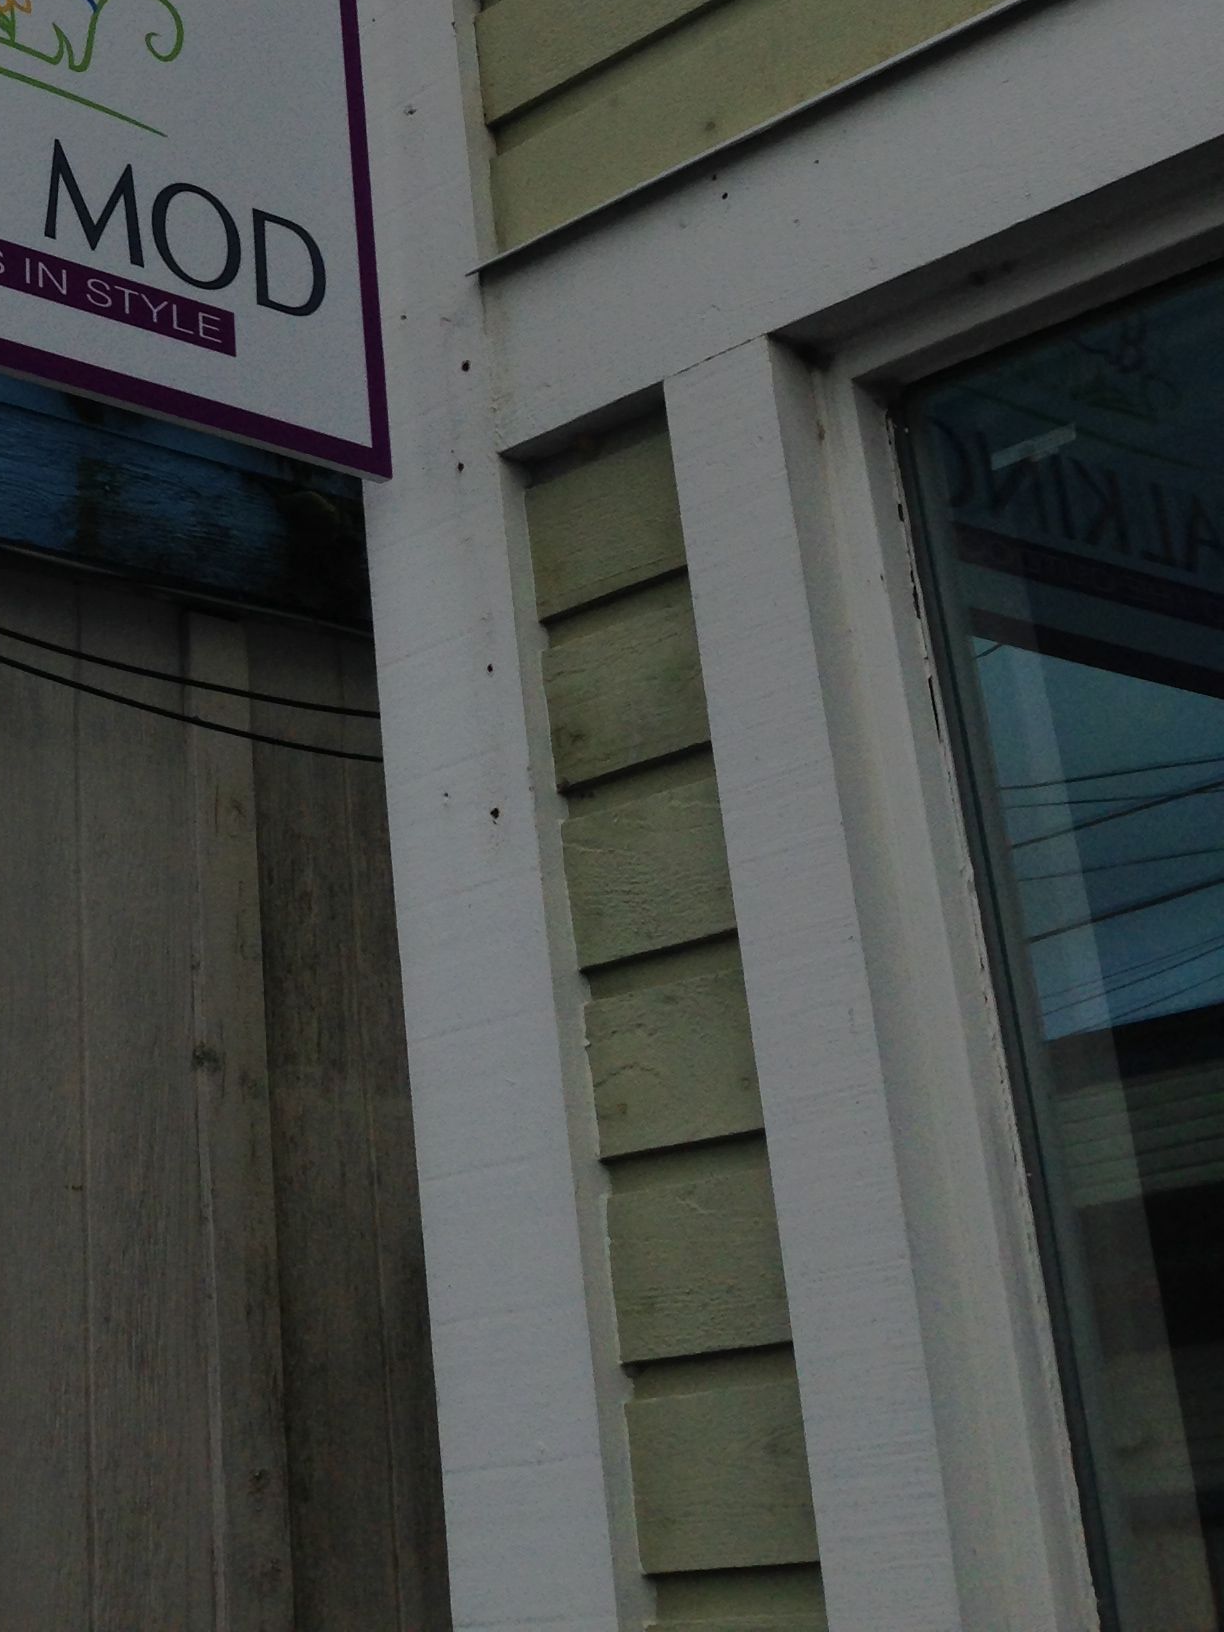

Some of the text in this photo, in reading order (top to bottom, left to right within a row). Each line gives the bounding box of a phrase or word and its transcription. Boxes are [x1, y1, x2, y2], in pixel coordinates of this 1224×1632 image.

[44, 138, 326, 317] MOD
[25, 258, 67, 296] IN
[86, 279, 223, 343] STYLE
